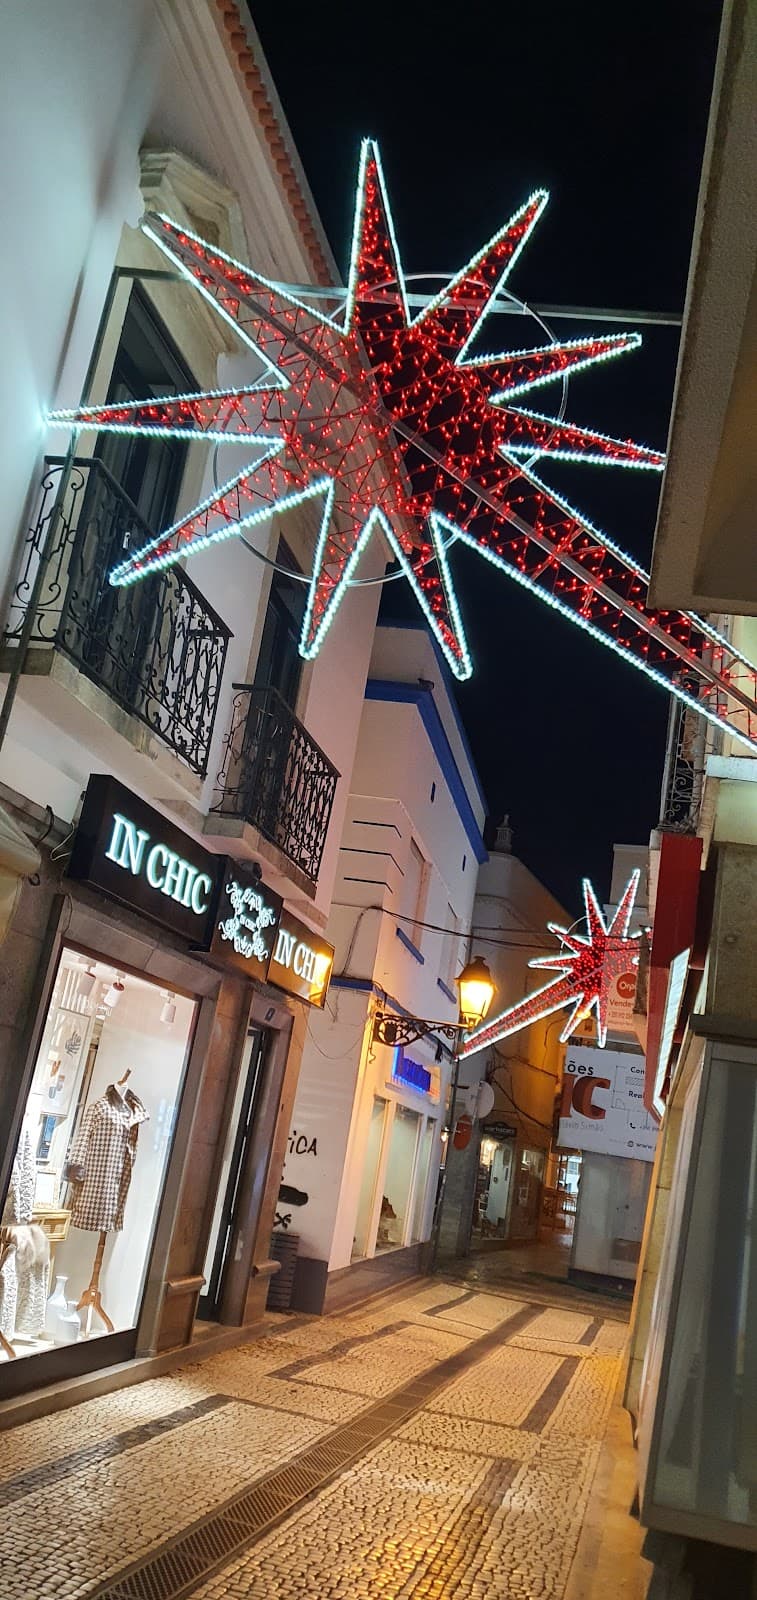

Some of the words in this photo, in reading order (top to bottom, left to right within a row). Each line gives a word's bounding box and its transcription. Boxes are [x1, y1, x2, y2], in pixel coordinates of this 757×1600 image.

[105, 813, 150, 876] IN
[146, 843, 212, 915] CHIC
[273, 928, 298, 969] IN
[288, 1130, 318, 1157] iCA
